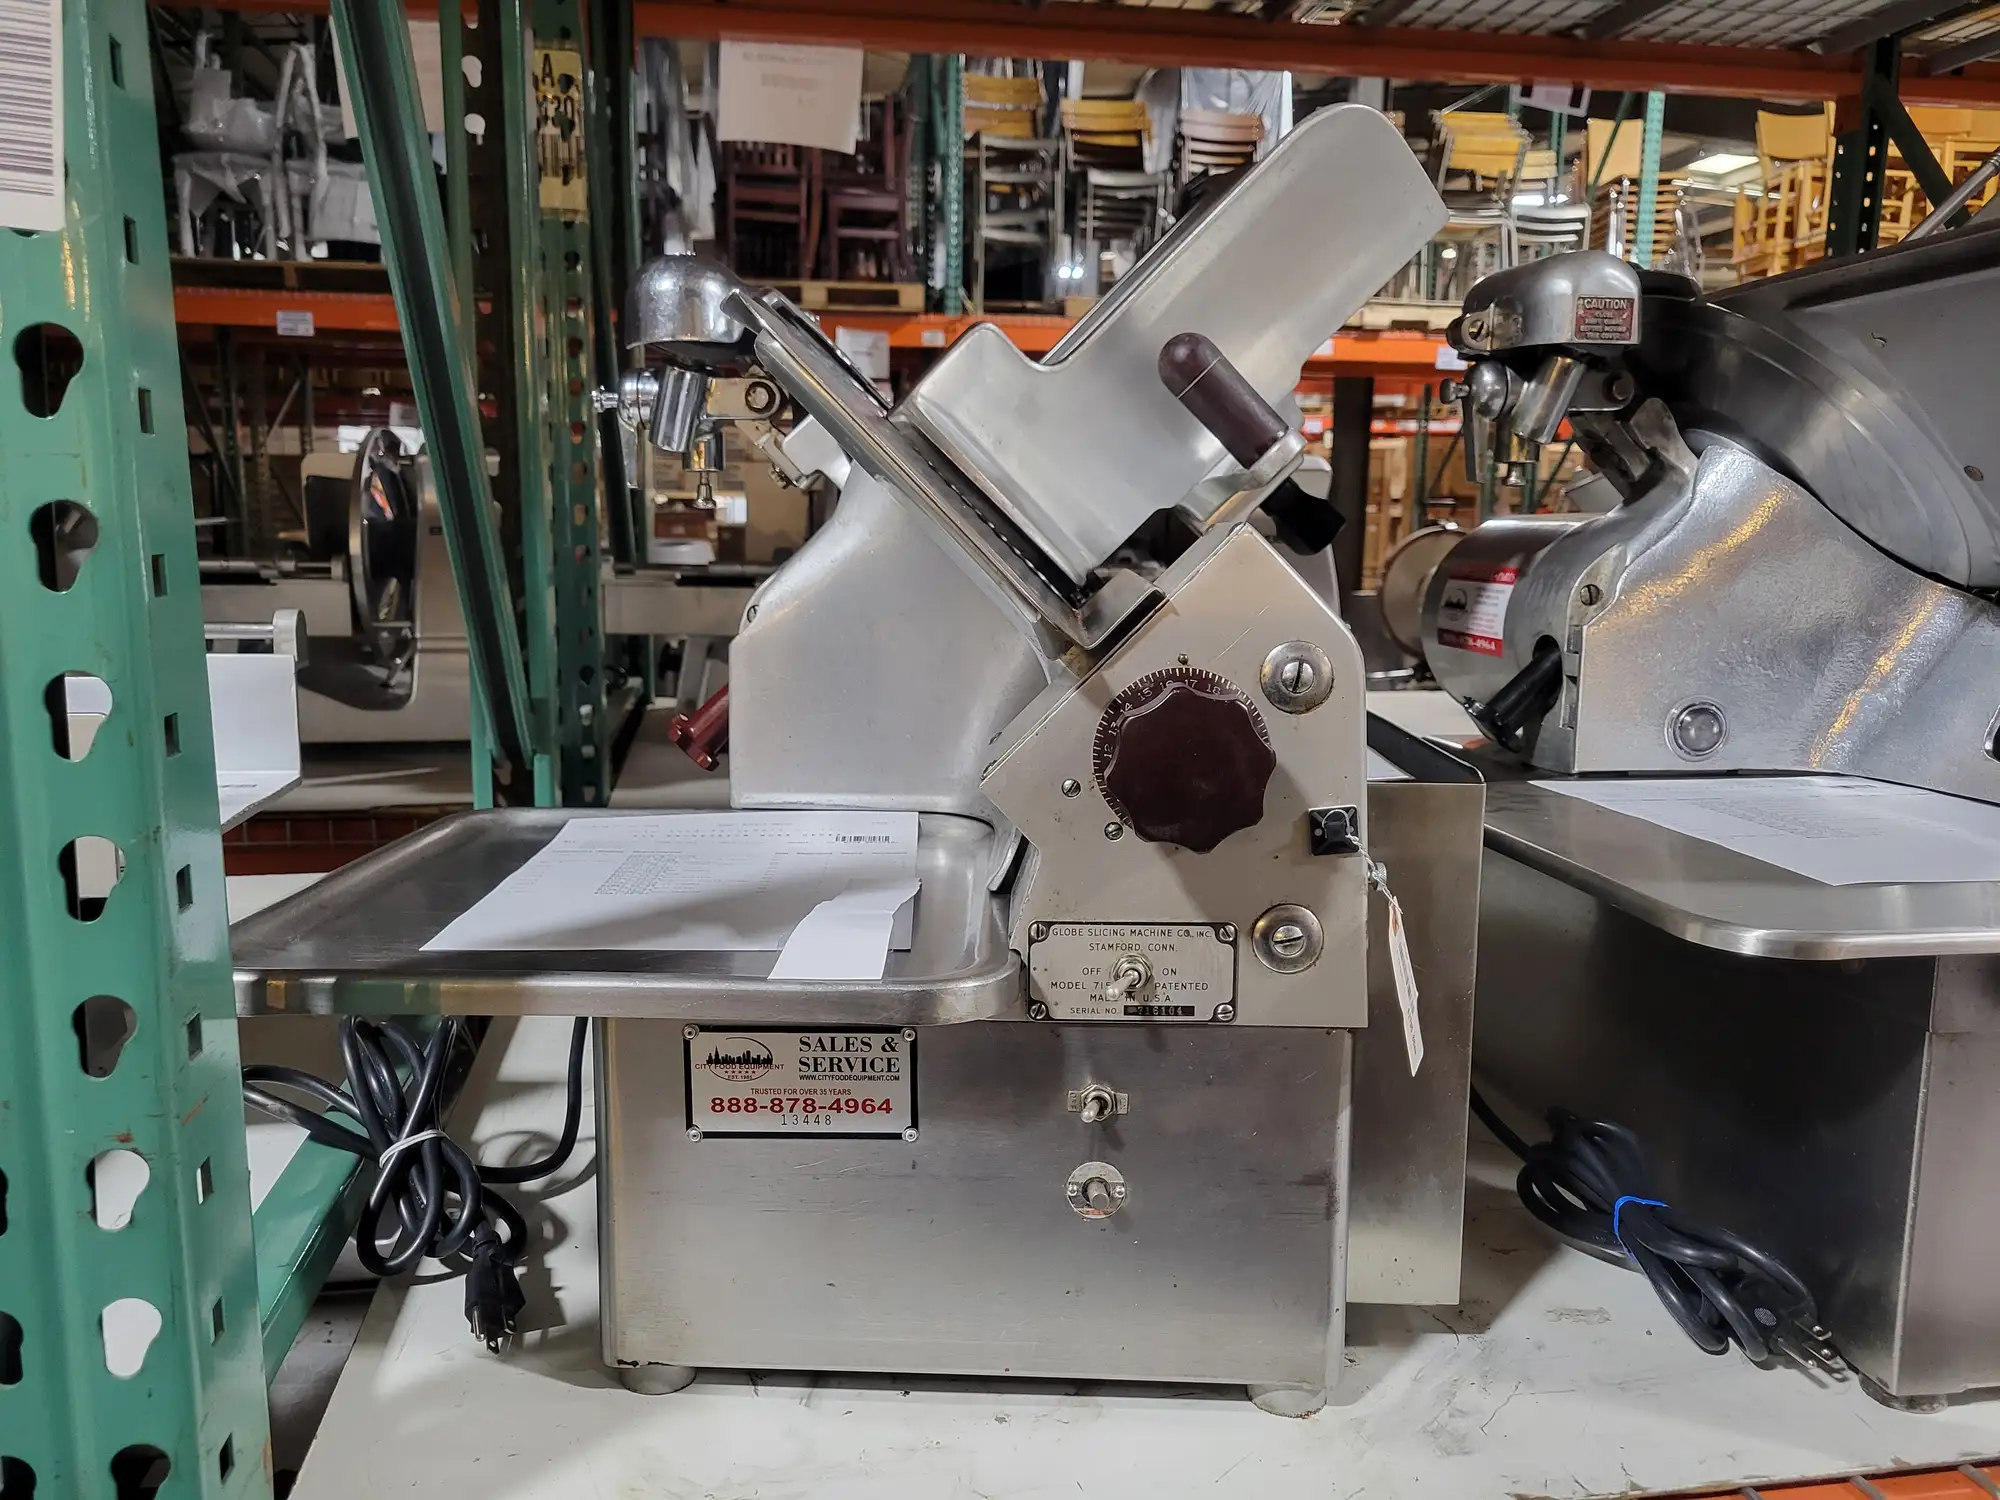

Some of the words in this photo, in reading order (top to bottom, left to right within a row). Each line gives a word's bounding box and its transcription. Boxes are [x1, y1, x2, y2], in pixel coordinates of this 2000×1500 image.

[1584, 298, 1627, 309] CAUTION
[1184, 679, 1198, 688] 17
[1206, 683, 1221, 695] 18
[1137, 687, 1153, 702] 15
[1108, 721, 1120, 736] 13
[1103, 743, 1114, 759] 12
[1052, 928, 1084, 937] GLOBE
[1087, 928, 1125, 937] SLICING
[1129, 929, 1173, 938] MACHINE
[1147, 943, 1178, 952] CONN.
[1082, 967, 1102, 976] OFF
[1162, 968, 1177, 976] ON
[1050, 981, 1087, 990] MODEL
[1154, 982, 1209, 991] PATENTED
[1089, 994, 1119, 1002] MA
[1125, 993, 1136, 1002] IN
[1142, 994, 1174, 1003] U.S.A.
[1070, 1007, 1102, 1015] SERIAL
[1104, 1007, 1119, 1015] NO.
[799, 1036, 873, 1052] SALES
[880, 1037, 900, 1052] &
[798, 1057, 900, 1073] SERVICE
[799, 1074, 900, 1082] WWW.CITYFOODEQUIPMENT.COM
[750, 1087, 782, 1096] TRUSTED
[829, 1088, 852, 1096] YEARS
[710, 1097, 893, 1114] 888-878-4964
[780, 1114, 832, 1126] 13448
